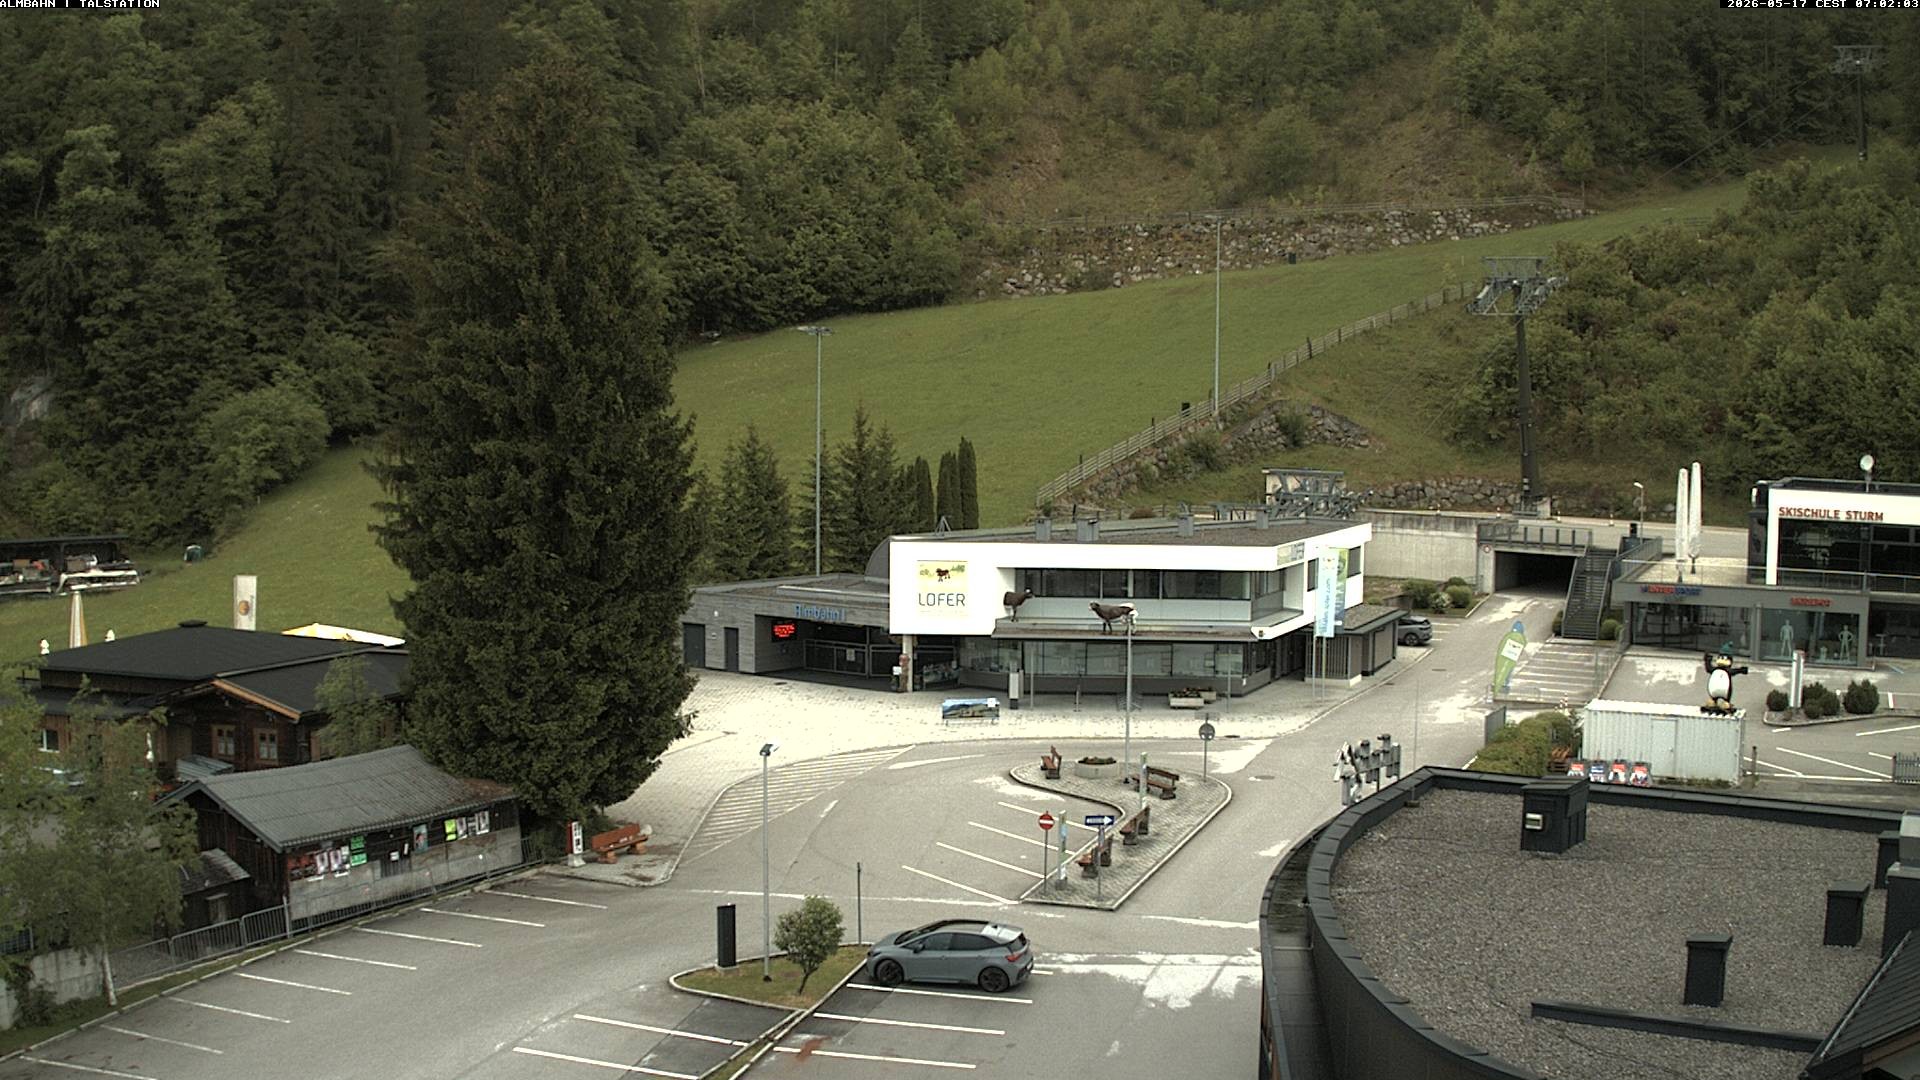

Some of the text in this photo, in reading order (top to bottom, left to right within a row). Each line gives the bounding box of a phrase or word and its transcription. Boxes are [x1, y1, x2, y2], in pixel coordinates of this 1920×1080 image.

[1778, 506, 1884, 521] SKISCHULE STURM
[918, 592, 966, 607] LOFER
